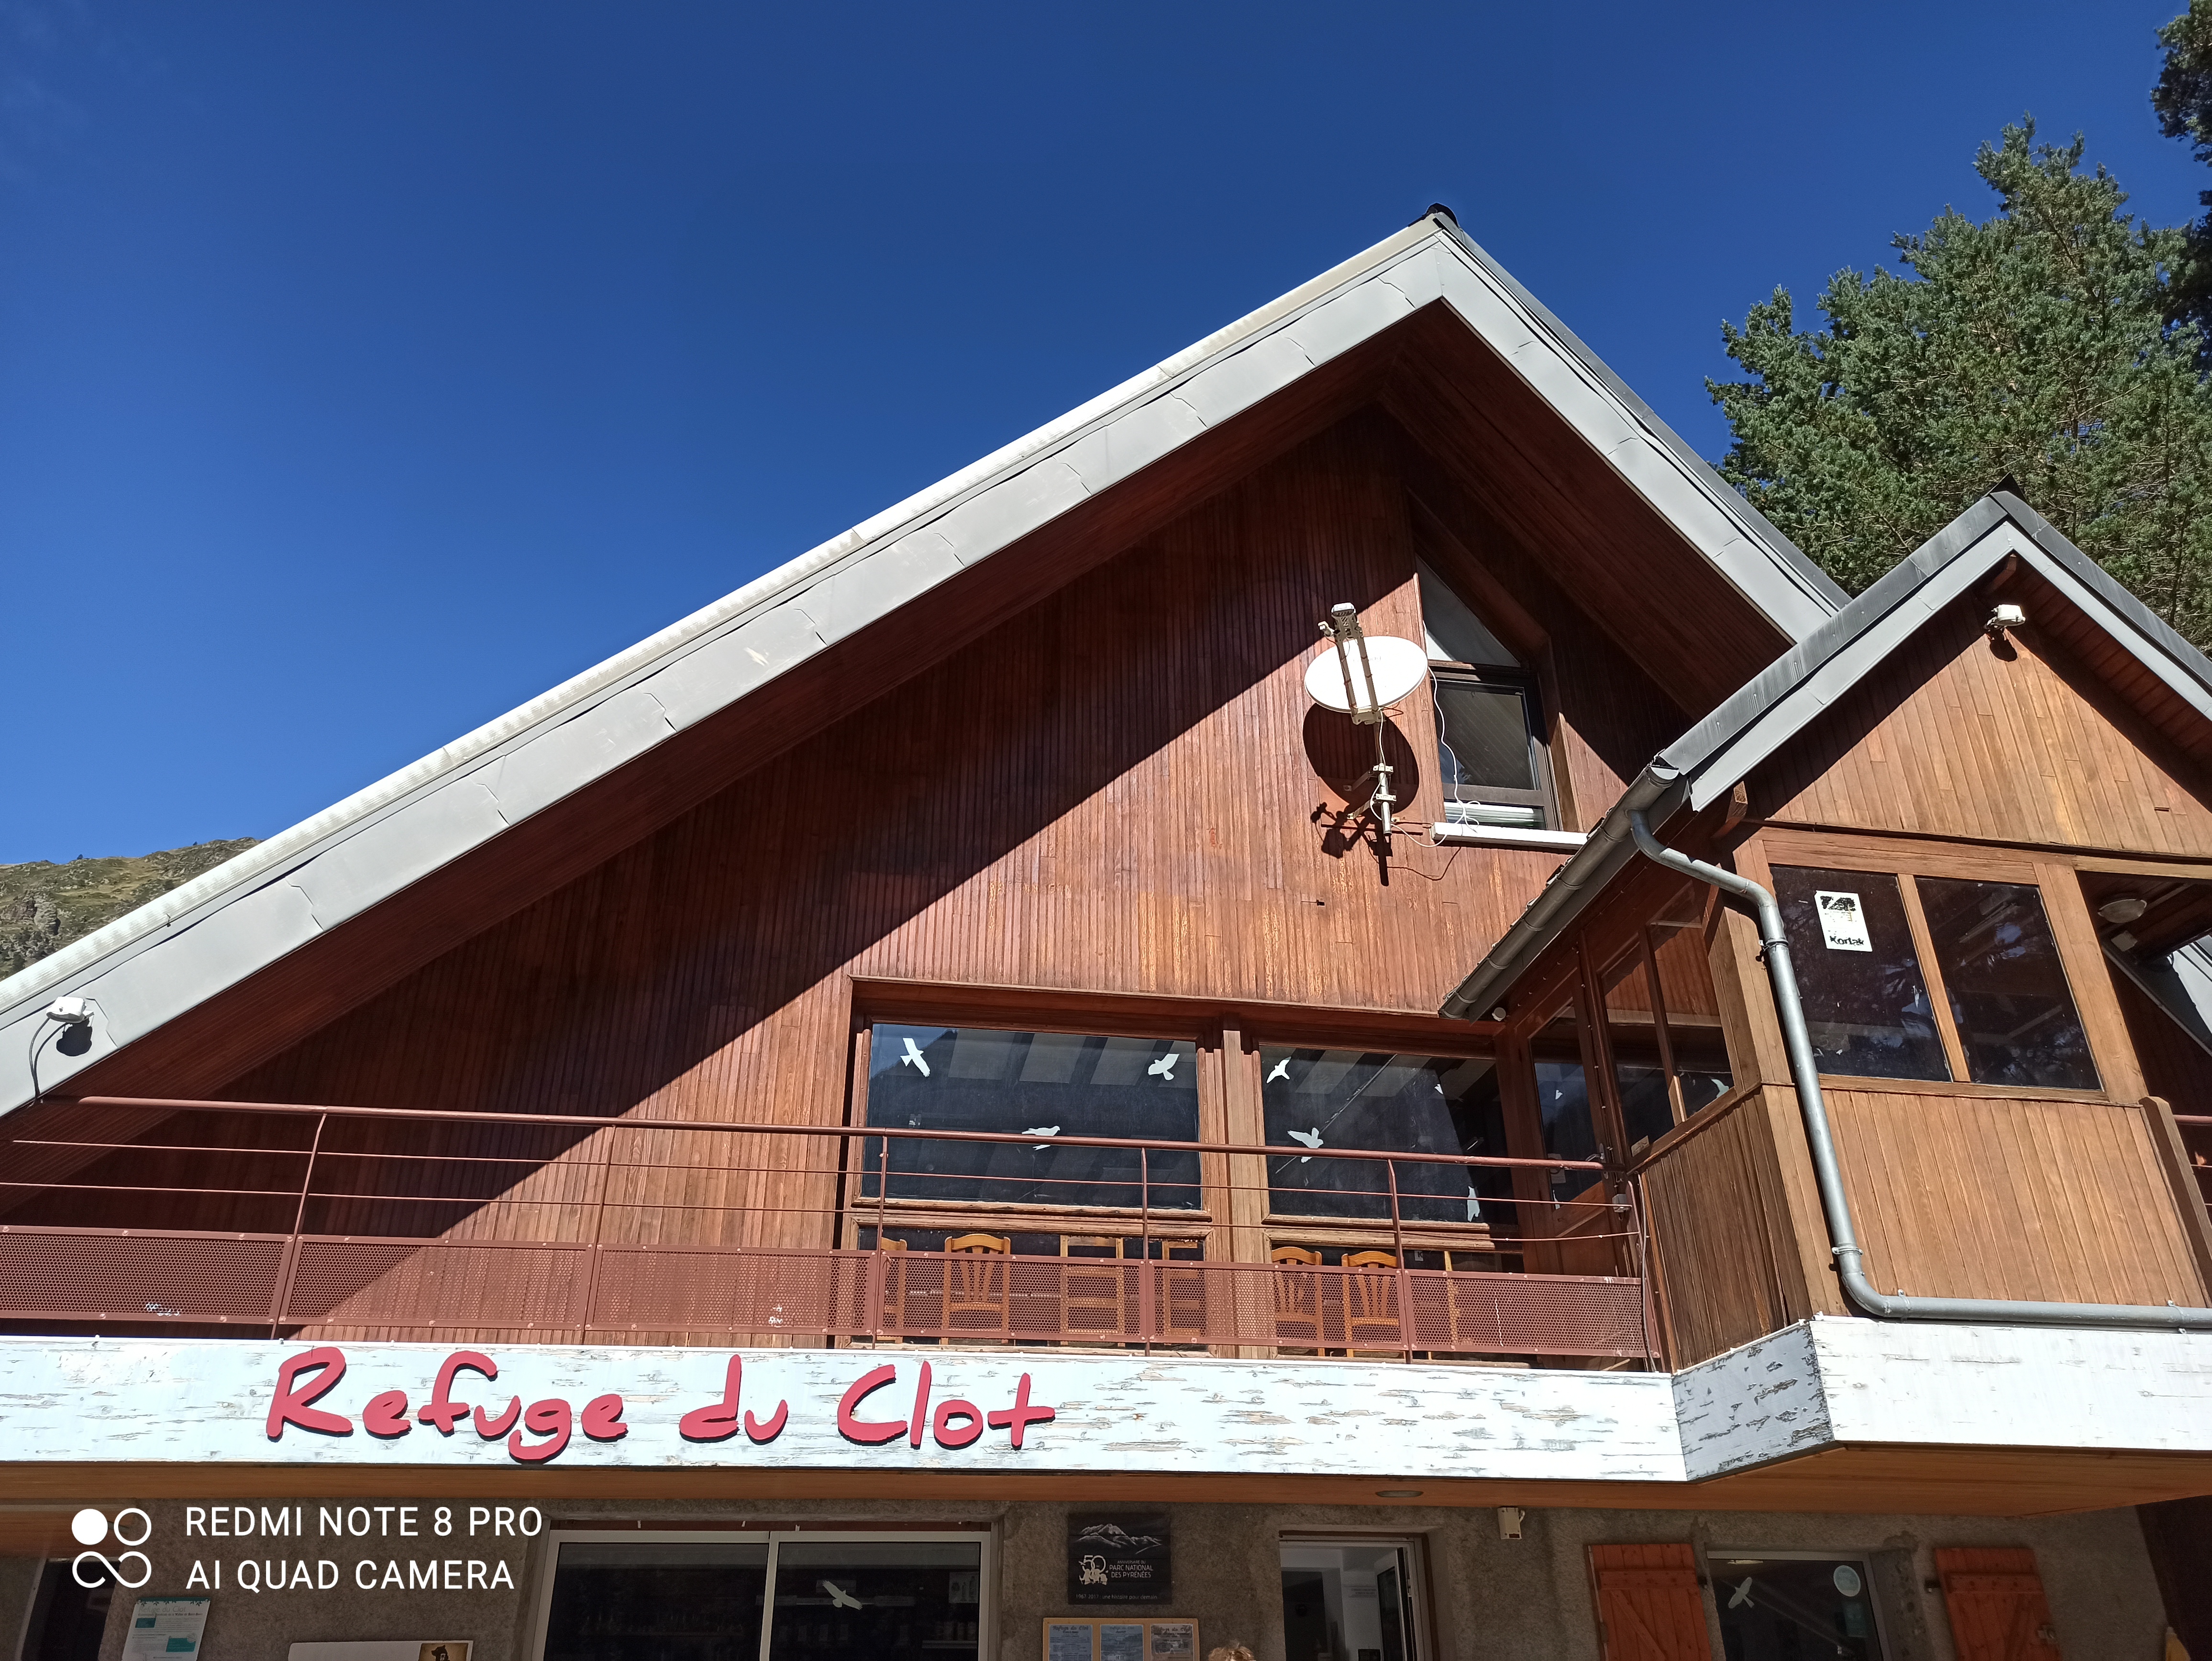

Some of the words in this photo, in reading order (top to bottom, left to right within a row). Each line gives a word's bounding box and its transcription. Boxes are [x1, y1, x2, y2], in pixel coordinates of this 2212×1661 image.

[267, 1346, 627, 1460] Refuge
[680, 1355, 788, 1440] du
[838, 1362, 1055, 1446] Clot
[1123, 1570, 1151, 1578] PYRÉNÉES
